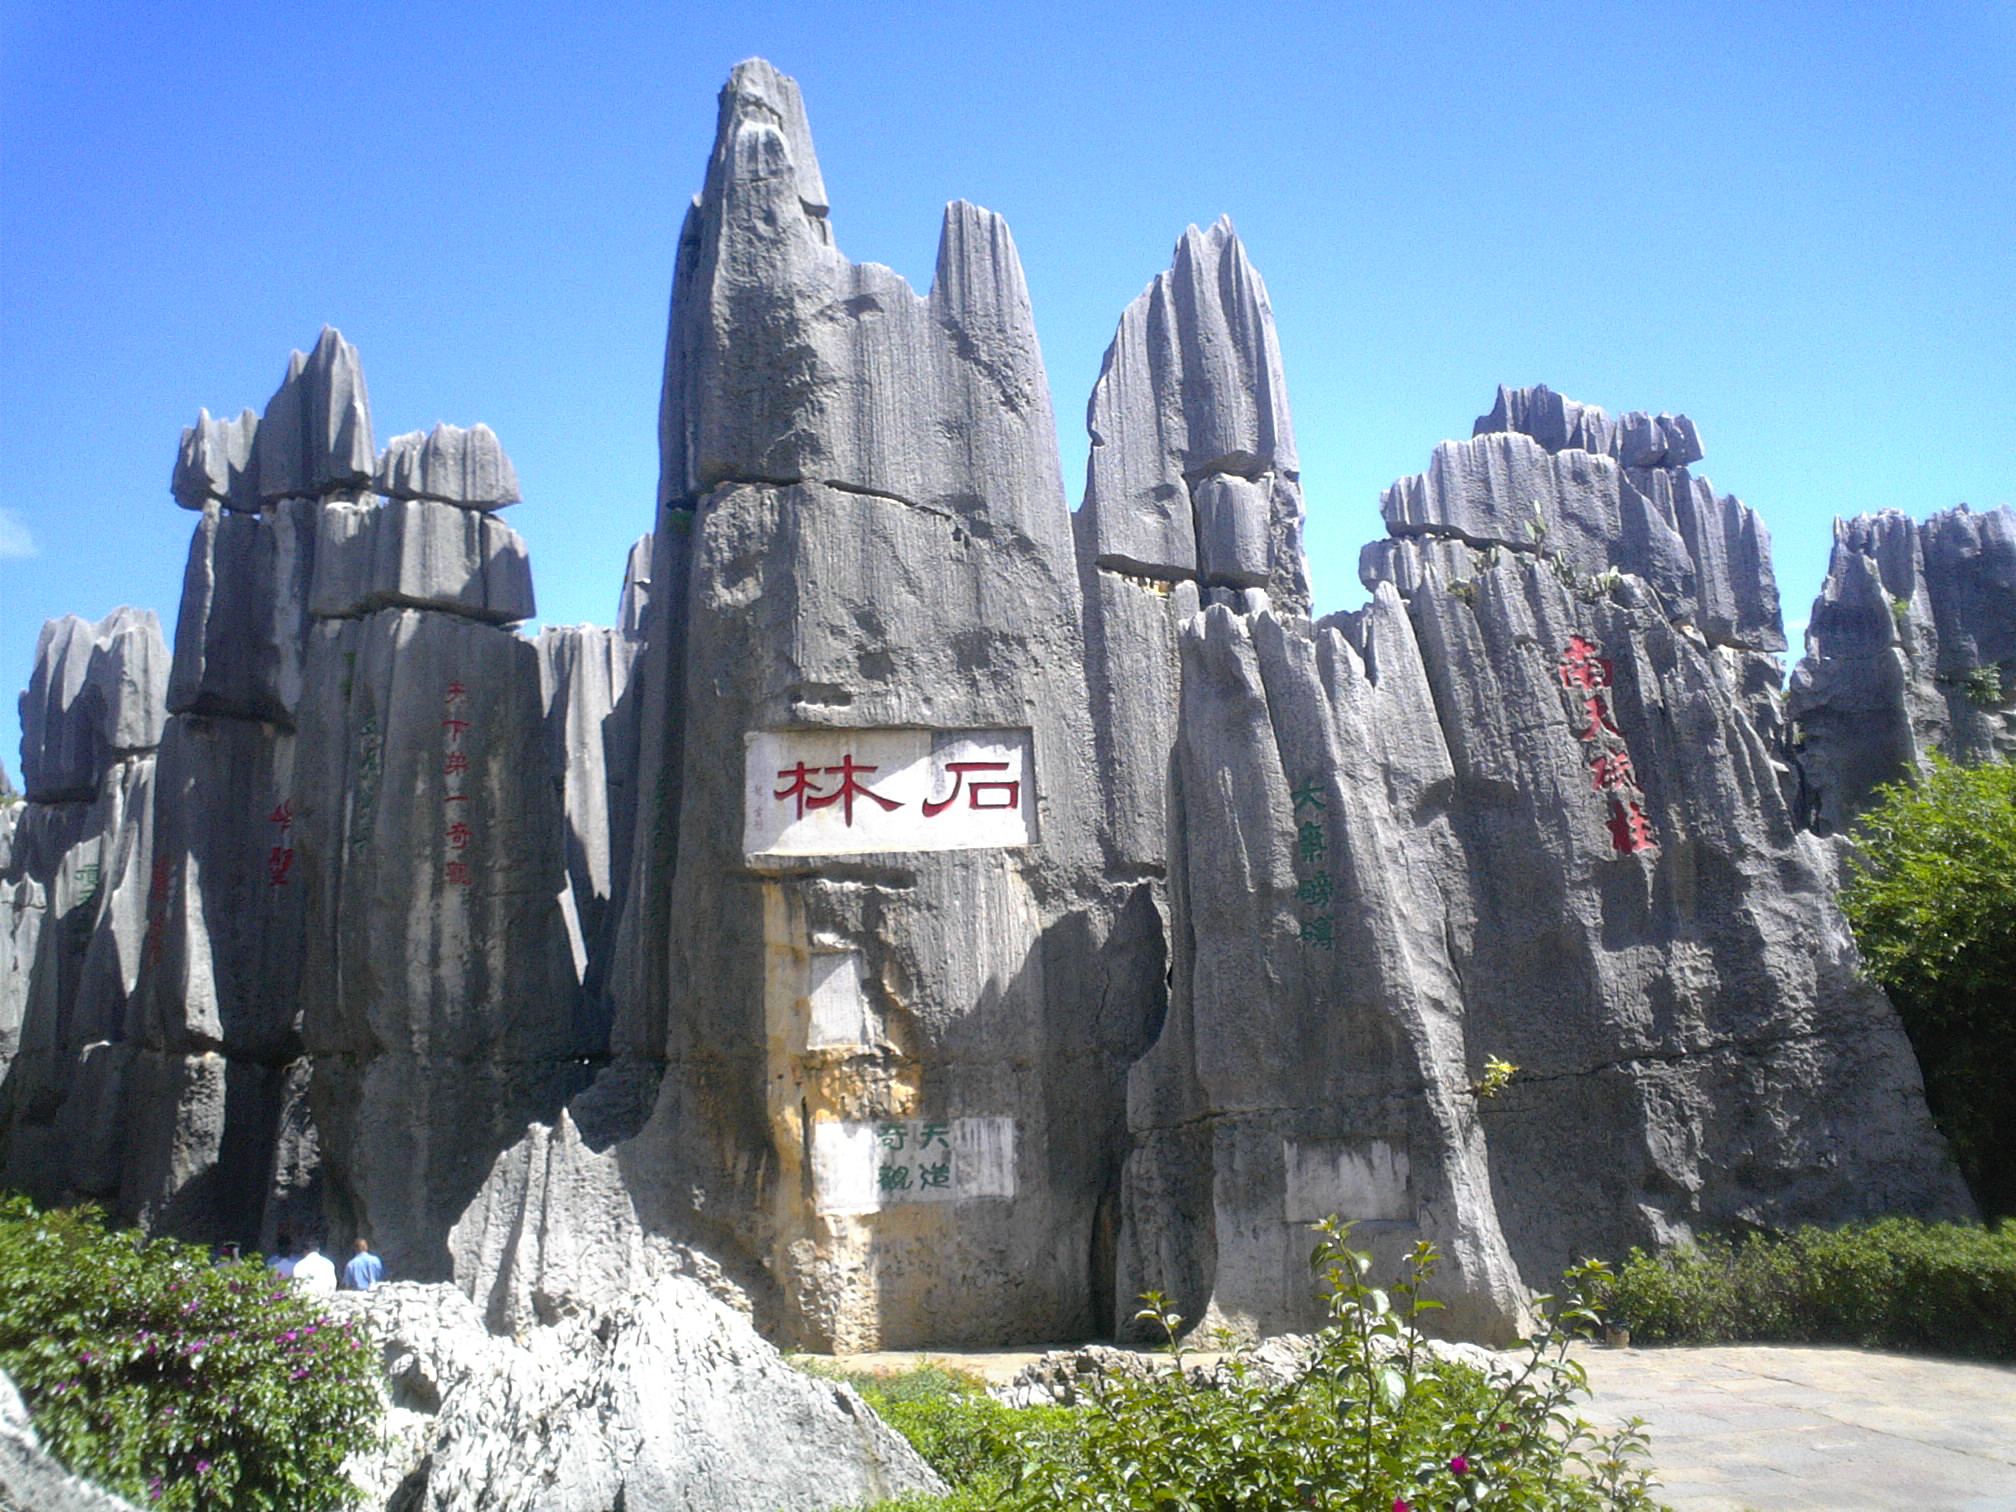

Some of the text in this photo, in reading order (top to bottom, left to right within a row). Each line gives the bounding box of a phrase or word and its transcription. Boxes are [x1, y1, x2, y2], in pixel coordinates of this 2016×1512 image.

[773, 754, 1019, 828] 石林
[1559, 635, 1661, 854] 南天砥柱
